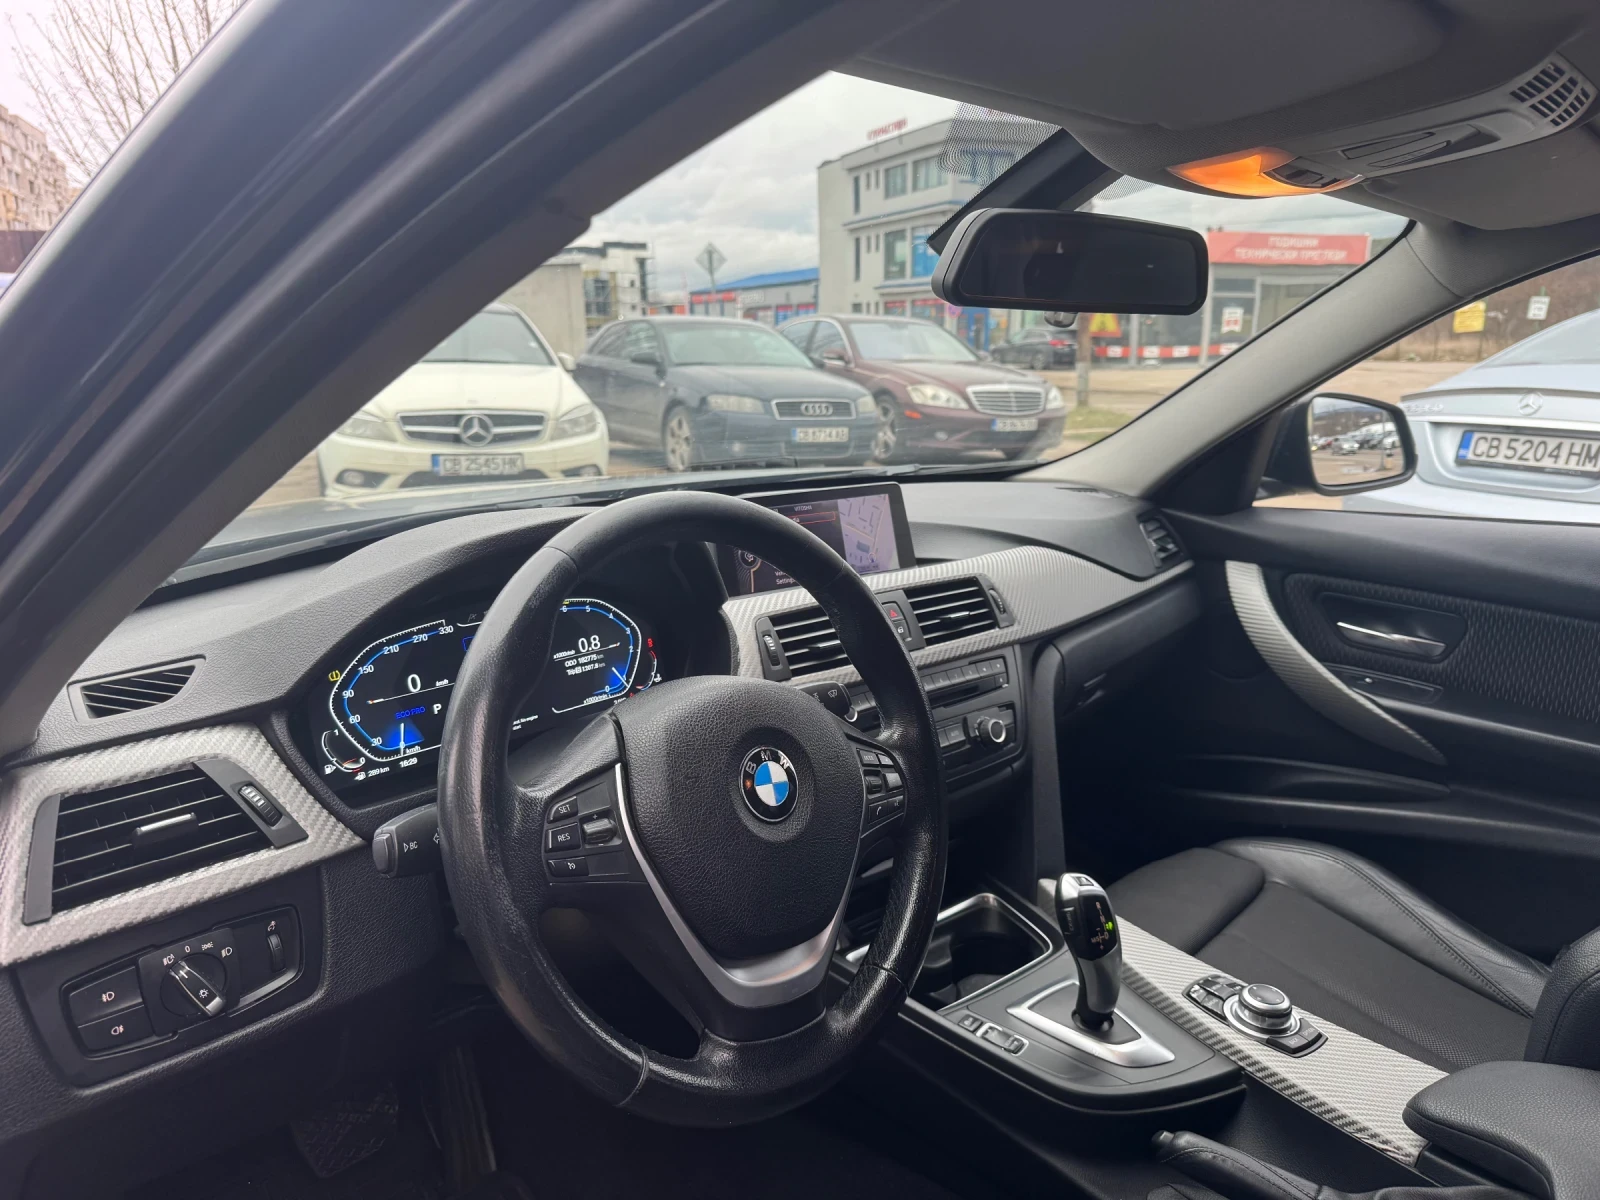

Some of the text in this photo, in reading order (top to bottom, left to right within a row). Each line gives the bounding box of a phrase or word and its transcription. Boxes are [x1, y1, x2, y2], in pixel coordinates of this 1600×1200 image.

[1473, 436, 1600, 468] CB 5204 HM
[443, 457, 461, 472] CB
[465, 457, 500, 471] 2545
[438, 625, 454, 635] 330
[412, 633, 428, 643] 270
[578, 634, 601, 653] 0.8
[383, 644, 400, 655] 210
[357, 664, 374, 675] 150
[407, 673, 422, 693] 0
[342, 689, 354, 699] 90
[395, 706, 426, 719] ECO PRO
[433, 703, 442, 715] P
[349, 714, 361, 724] 60
[371, 737, 382, 747] 30
[558, 804, 571, 814] SET
[557, 832, 571, 842] RES
